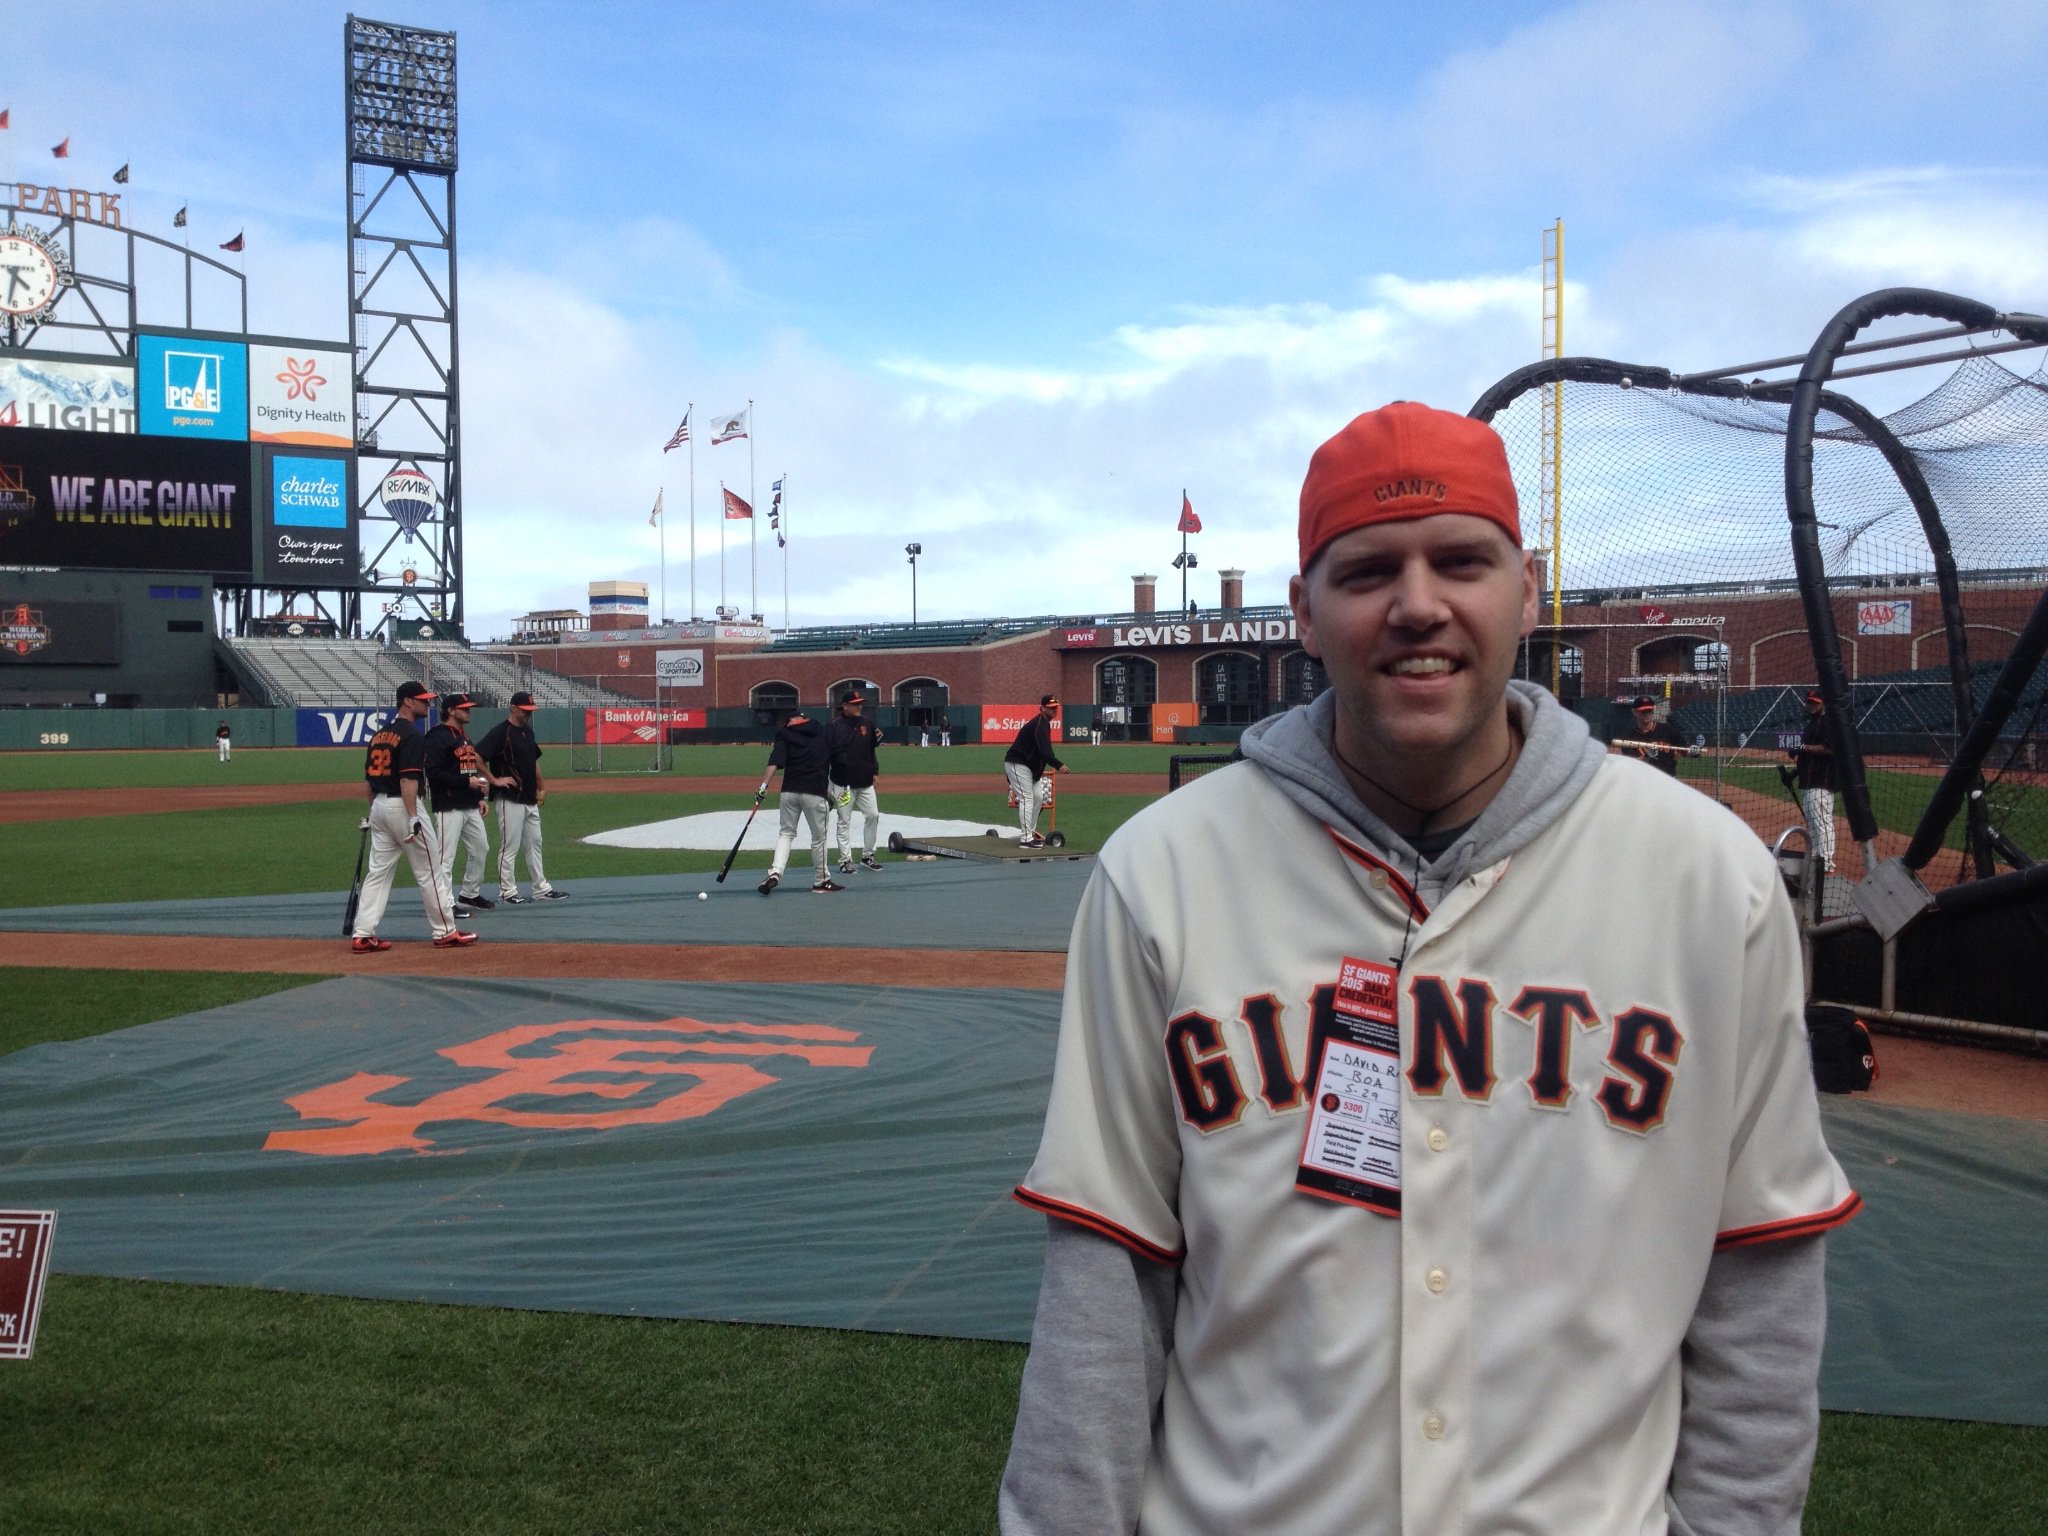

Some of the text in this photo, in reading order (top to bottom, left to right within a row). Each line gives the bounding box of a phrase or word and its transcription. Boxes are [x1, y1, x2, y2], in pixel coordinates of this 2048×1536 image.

[15, 182, 121, 230] PARK
[9, 241, 19, 250] 12
[40, 259, 46, 267] 2
[46, 274, 52, 283] 3
[39, 288, 46, 297] 4
[12, 300, 18, 309] 6
[28, 297, 34, 306] 5
[168, 385, 217, 410] PG&E
[28, 402, 135, 433] LIGHT
[172, 415, 214, 427] pge.com
[257, 405, 346, 423] Dignity Health
[280, 475, 339, 495] charles
[388, 478, 430, 497] RE/MAX
[1374, 479, 1446, 504] GIANTS
[50, 474, 95, 523] WE
[101, 478, 153, 526] ARE
[157, 480, 236, 529] GIANT
[280, 493, 340, 508] SCHWAB
[278, 534, 343, 555] Own your
[1671, 614, 1726, 626] america
[1860, 605, 1894, 625] AAA
[0, 632, 46, 640] CHAMPIONS
[8, 626, 37, 634] WORLD
[1202, 620, 1298, 644] LANDI
[605, 710, 689, 722] Bank of America
[318, 711, 398, 744] VIS
[1069, 726, 1088, 737] 365
[1156, 725, 1173, 734] Han
[40, 732, 69, 745] 399
[1778, 734, 1801, 750] KNB
[1343, 963, 1391, 986] SF GIANTS
[1340, 976, 1392, 997] 2015 DAILY
[1338, 987, 1394, 1011] CREDENTIAL
[1343, 1052, 1380, 1074] DAVID
[1386, 1065, 1400, 1080] R
[1353, 1070, 1383, 1090] BOA
[1343, 1101, 1363, 1114] 5300
